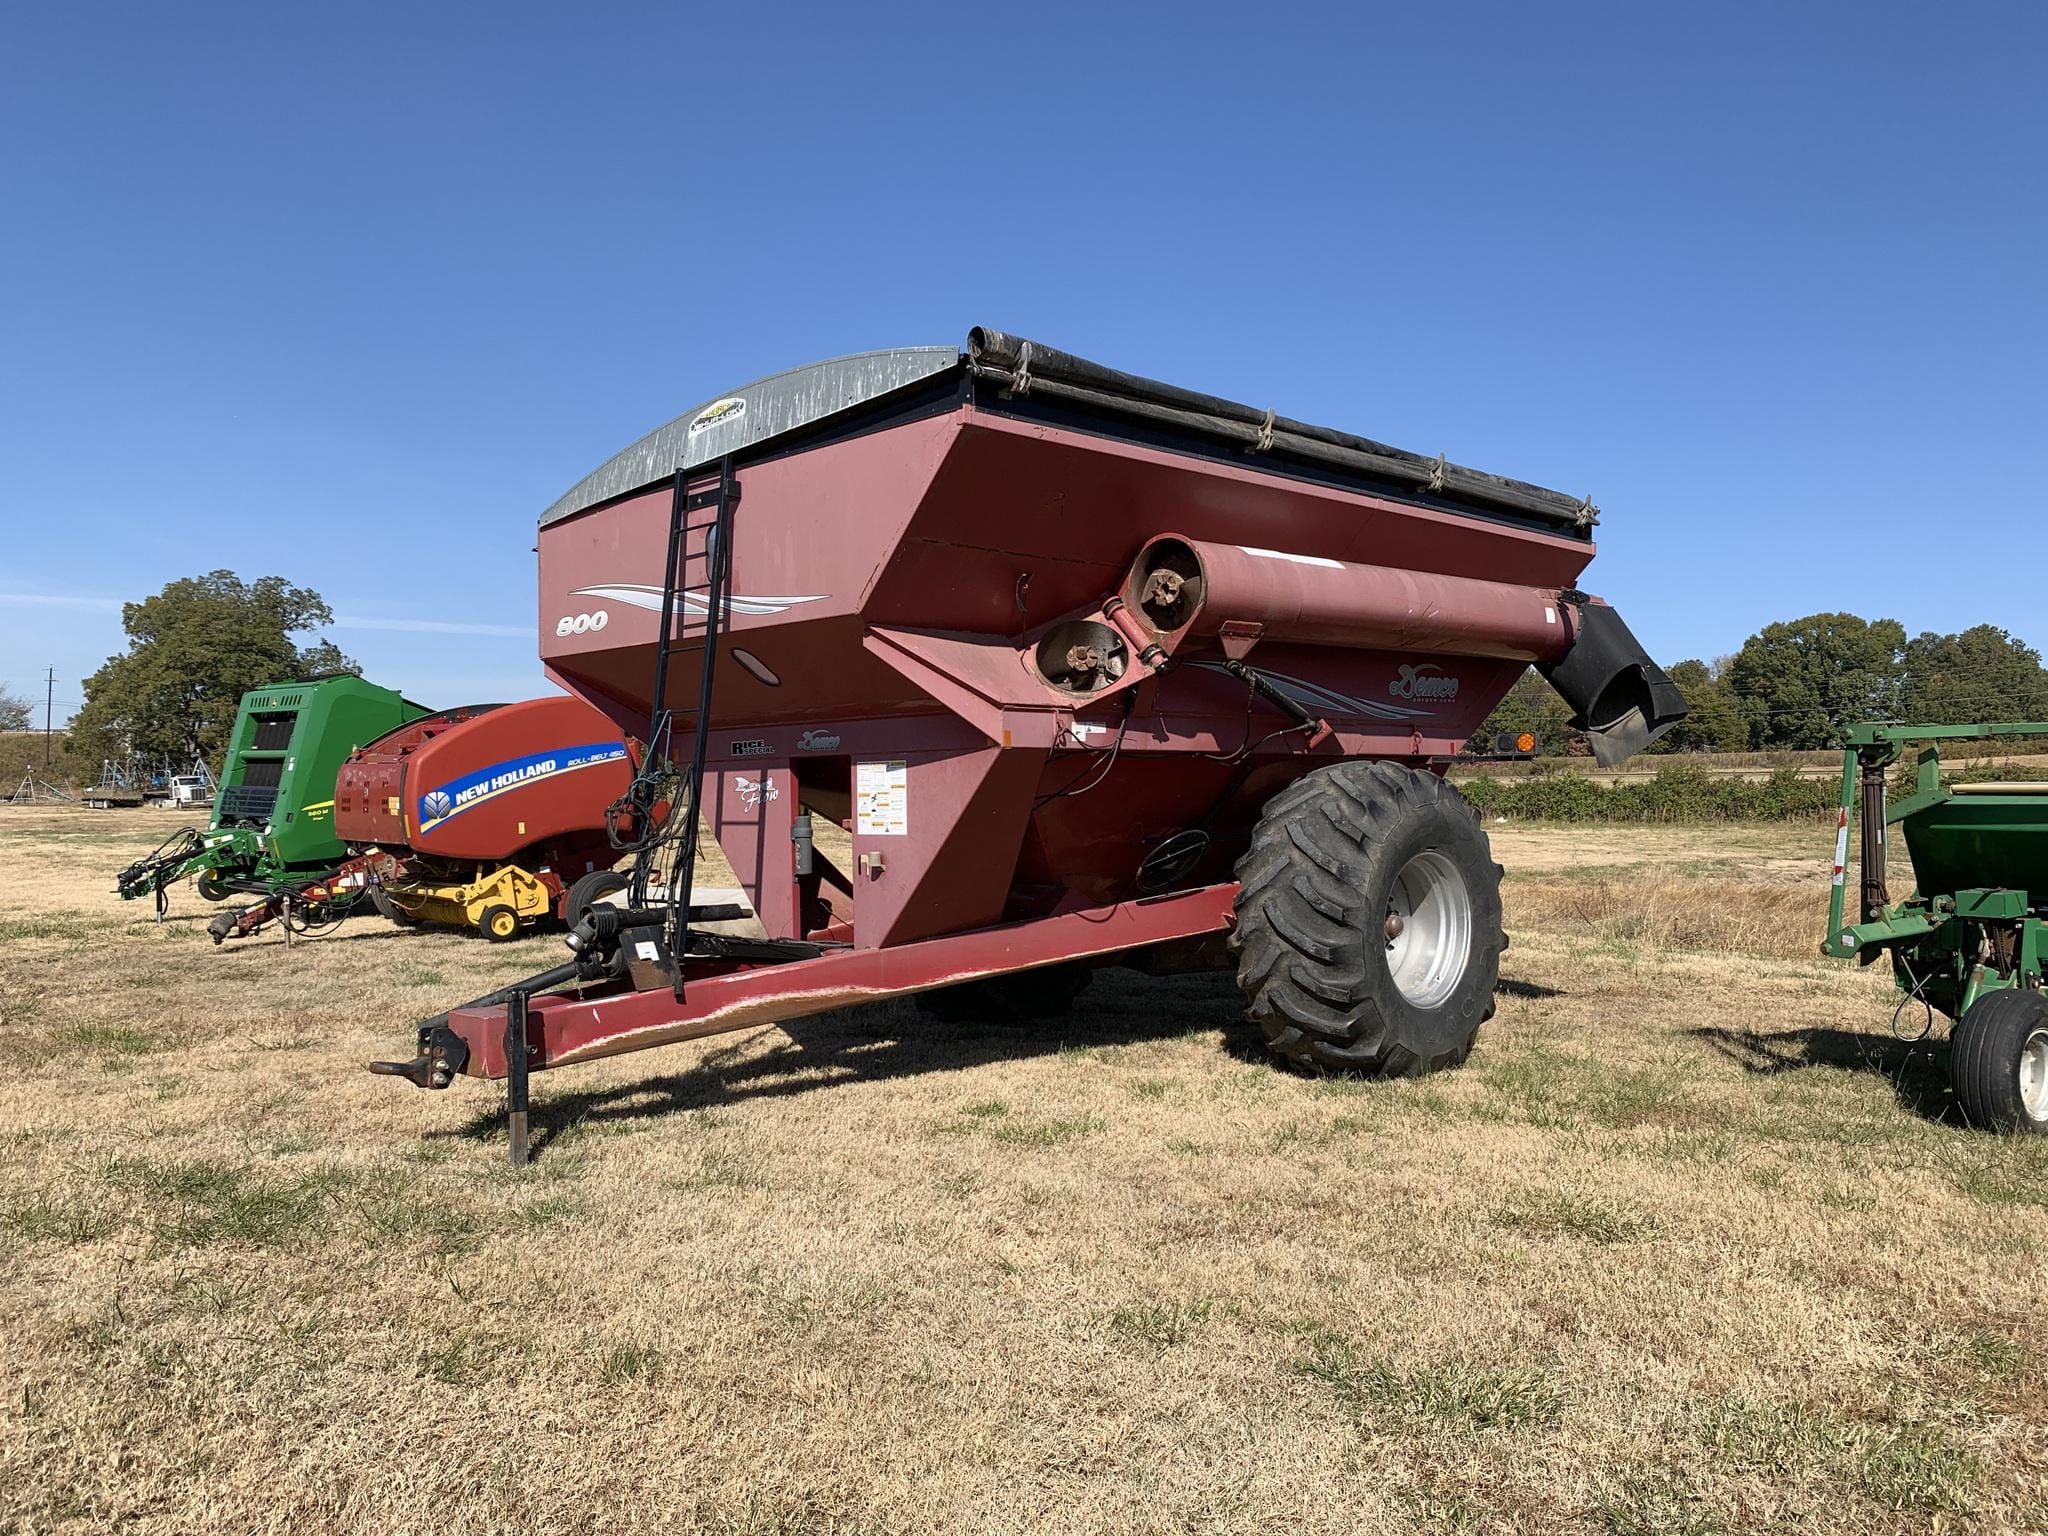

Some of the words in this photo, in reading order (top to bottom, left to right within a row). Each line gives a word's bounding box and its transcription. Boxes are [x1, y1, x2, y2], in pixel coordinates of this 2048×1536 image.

[556, 610, 609, 637] 800
[1389, 664, 1459, 699] Demco
[731, 740, 765, 756] RICE
[743, 745, 776, 754] SPECIAL
[455, 781, 489, 806] NEW
[491, 759, 556, 790] HOLLAND
